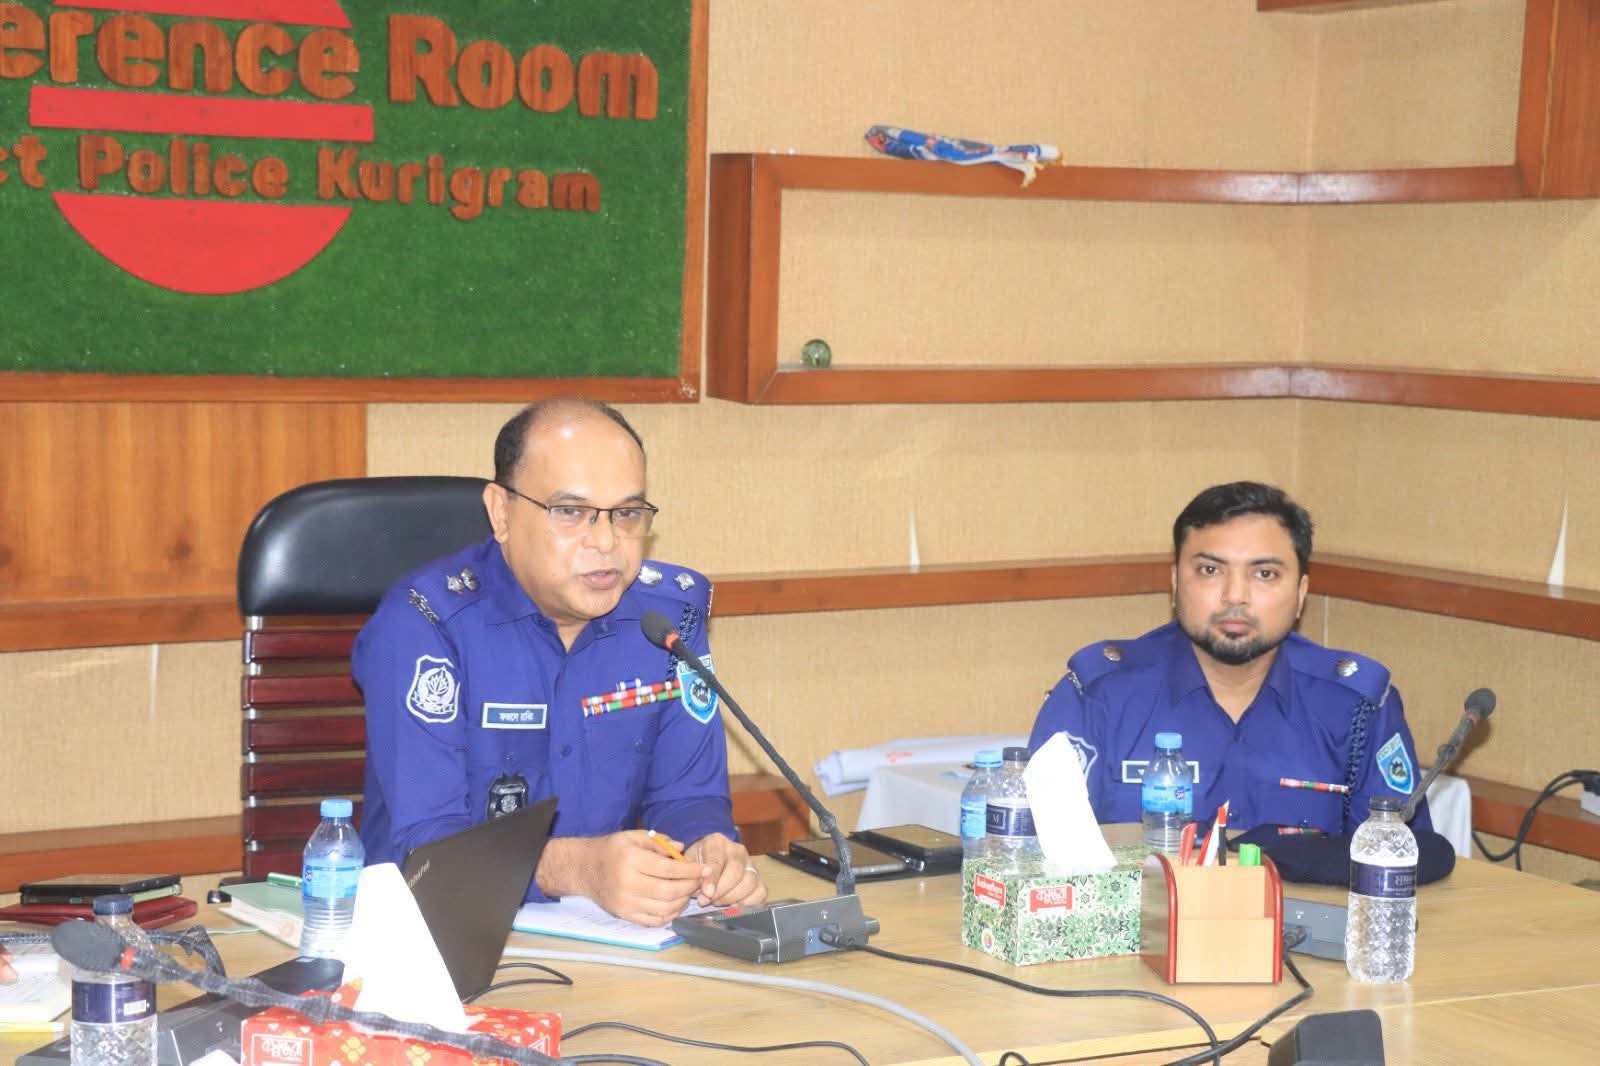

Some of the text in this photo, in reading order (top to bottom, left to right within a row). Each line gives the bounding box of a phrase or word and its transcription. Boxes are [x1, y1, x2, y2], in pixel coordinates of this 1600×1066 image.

[0, 3, 658, 120] erence Room
[0, 134, 601, 221] t Police Kurigram
